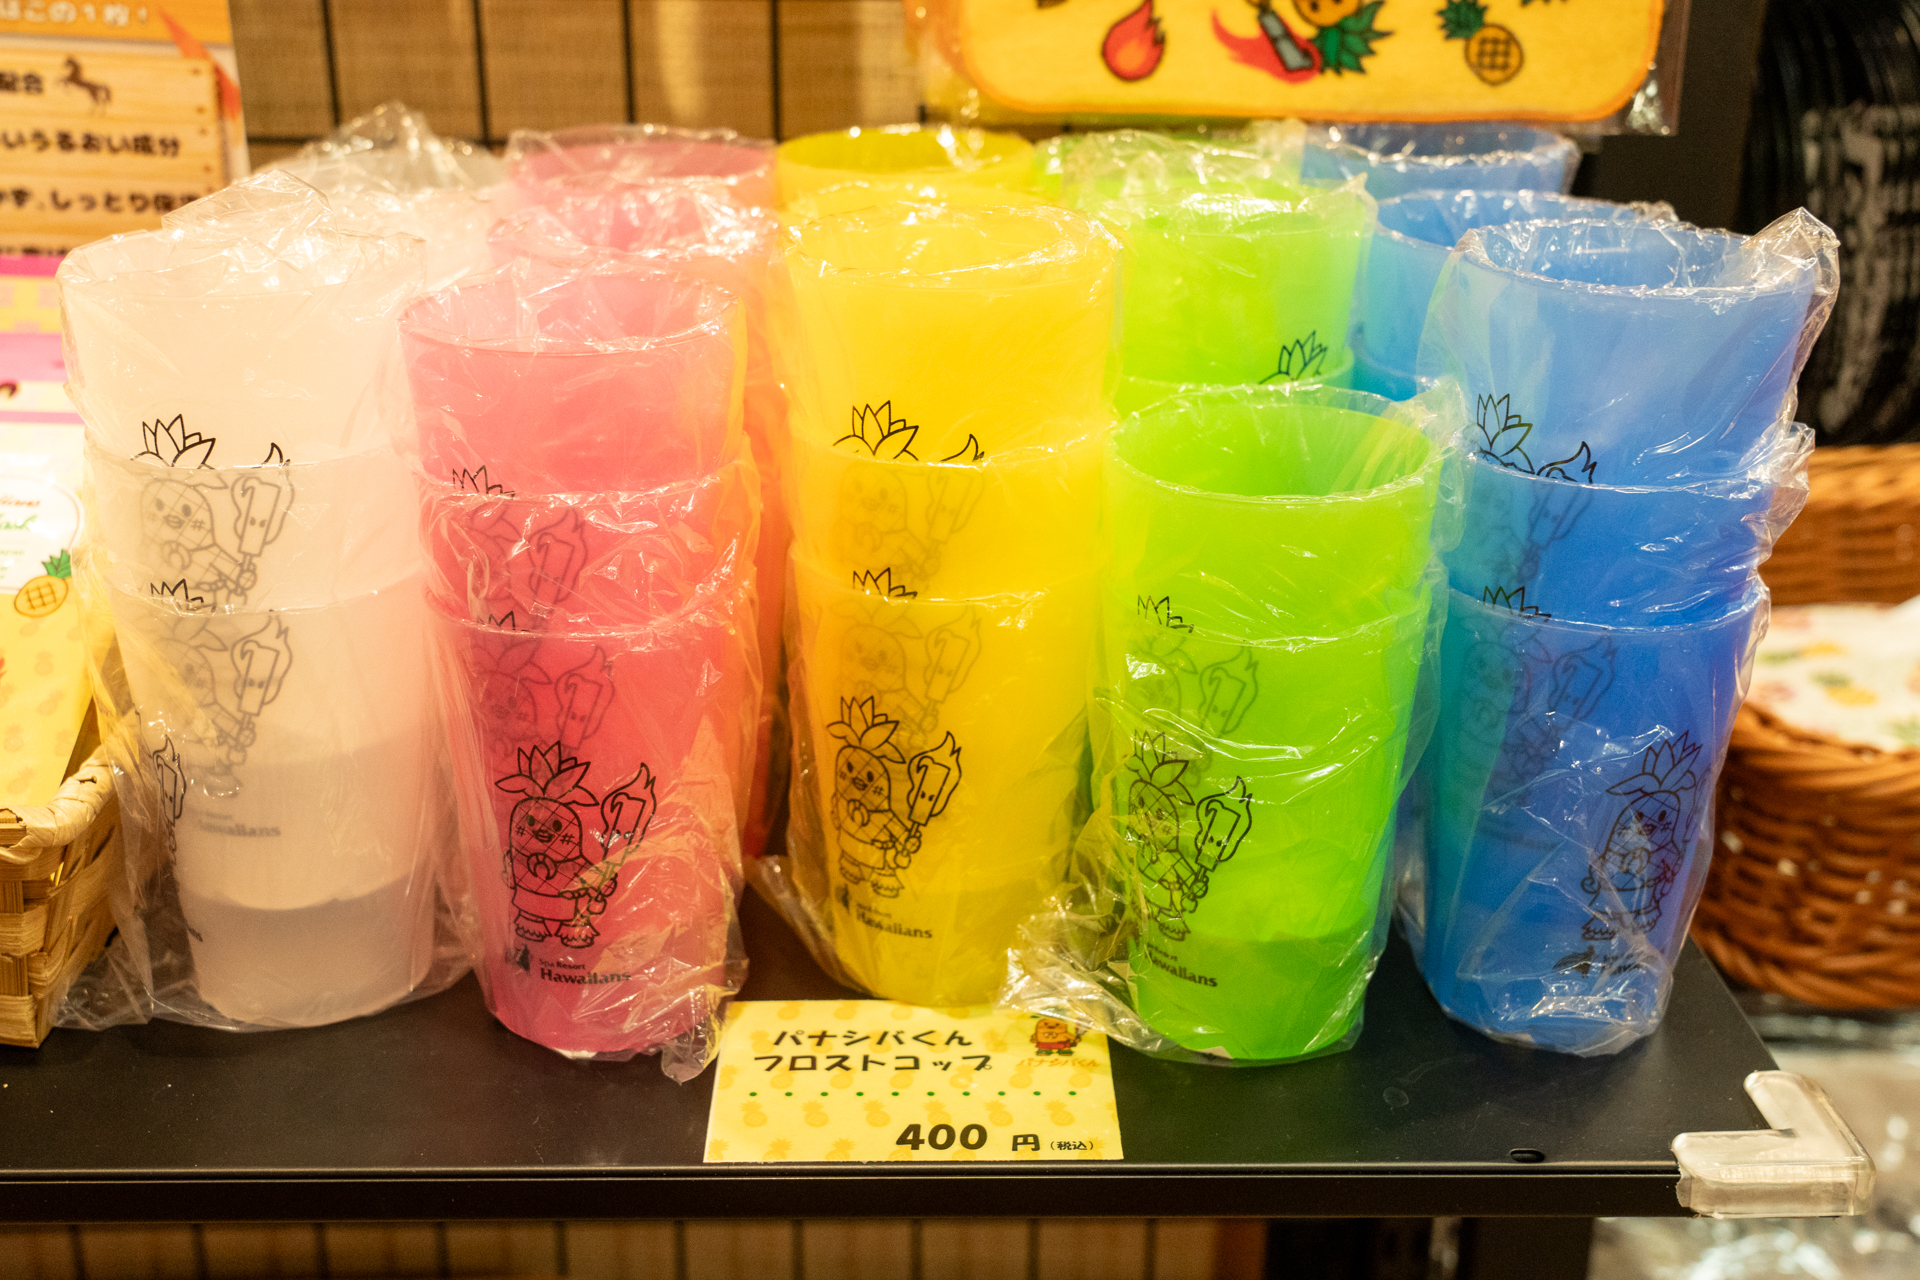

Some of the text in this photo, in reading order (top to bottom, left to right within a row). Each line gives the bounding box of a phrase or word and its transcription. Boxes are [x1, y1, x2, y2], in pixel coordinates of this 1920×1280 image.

[556, 959, 586, 971] Resort
[540, 967, 631, 985] Hawaiians
[773, 1030, 973, 1047] パナシバくん
[754, 1054, 993, 1072] フロストコップ
[896, 1123, 988, 1151] 400
[1012, 1133, 1041, 1152] 円
